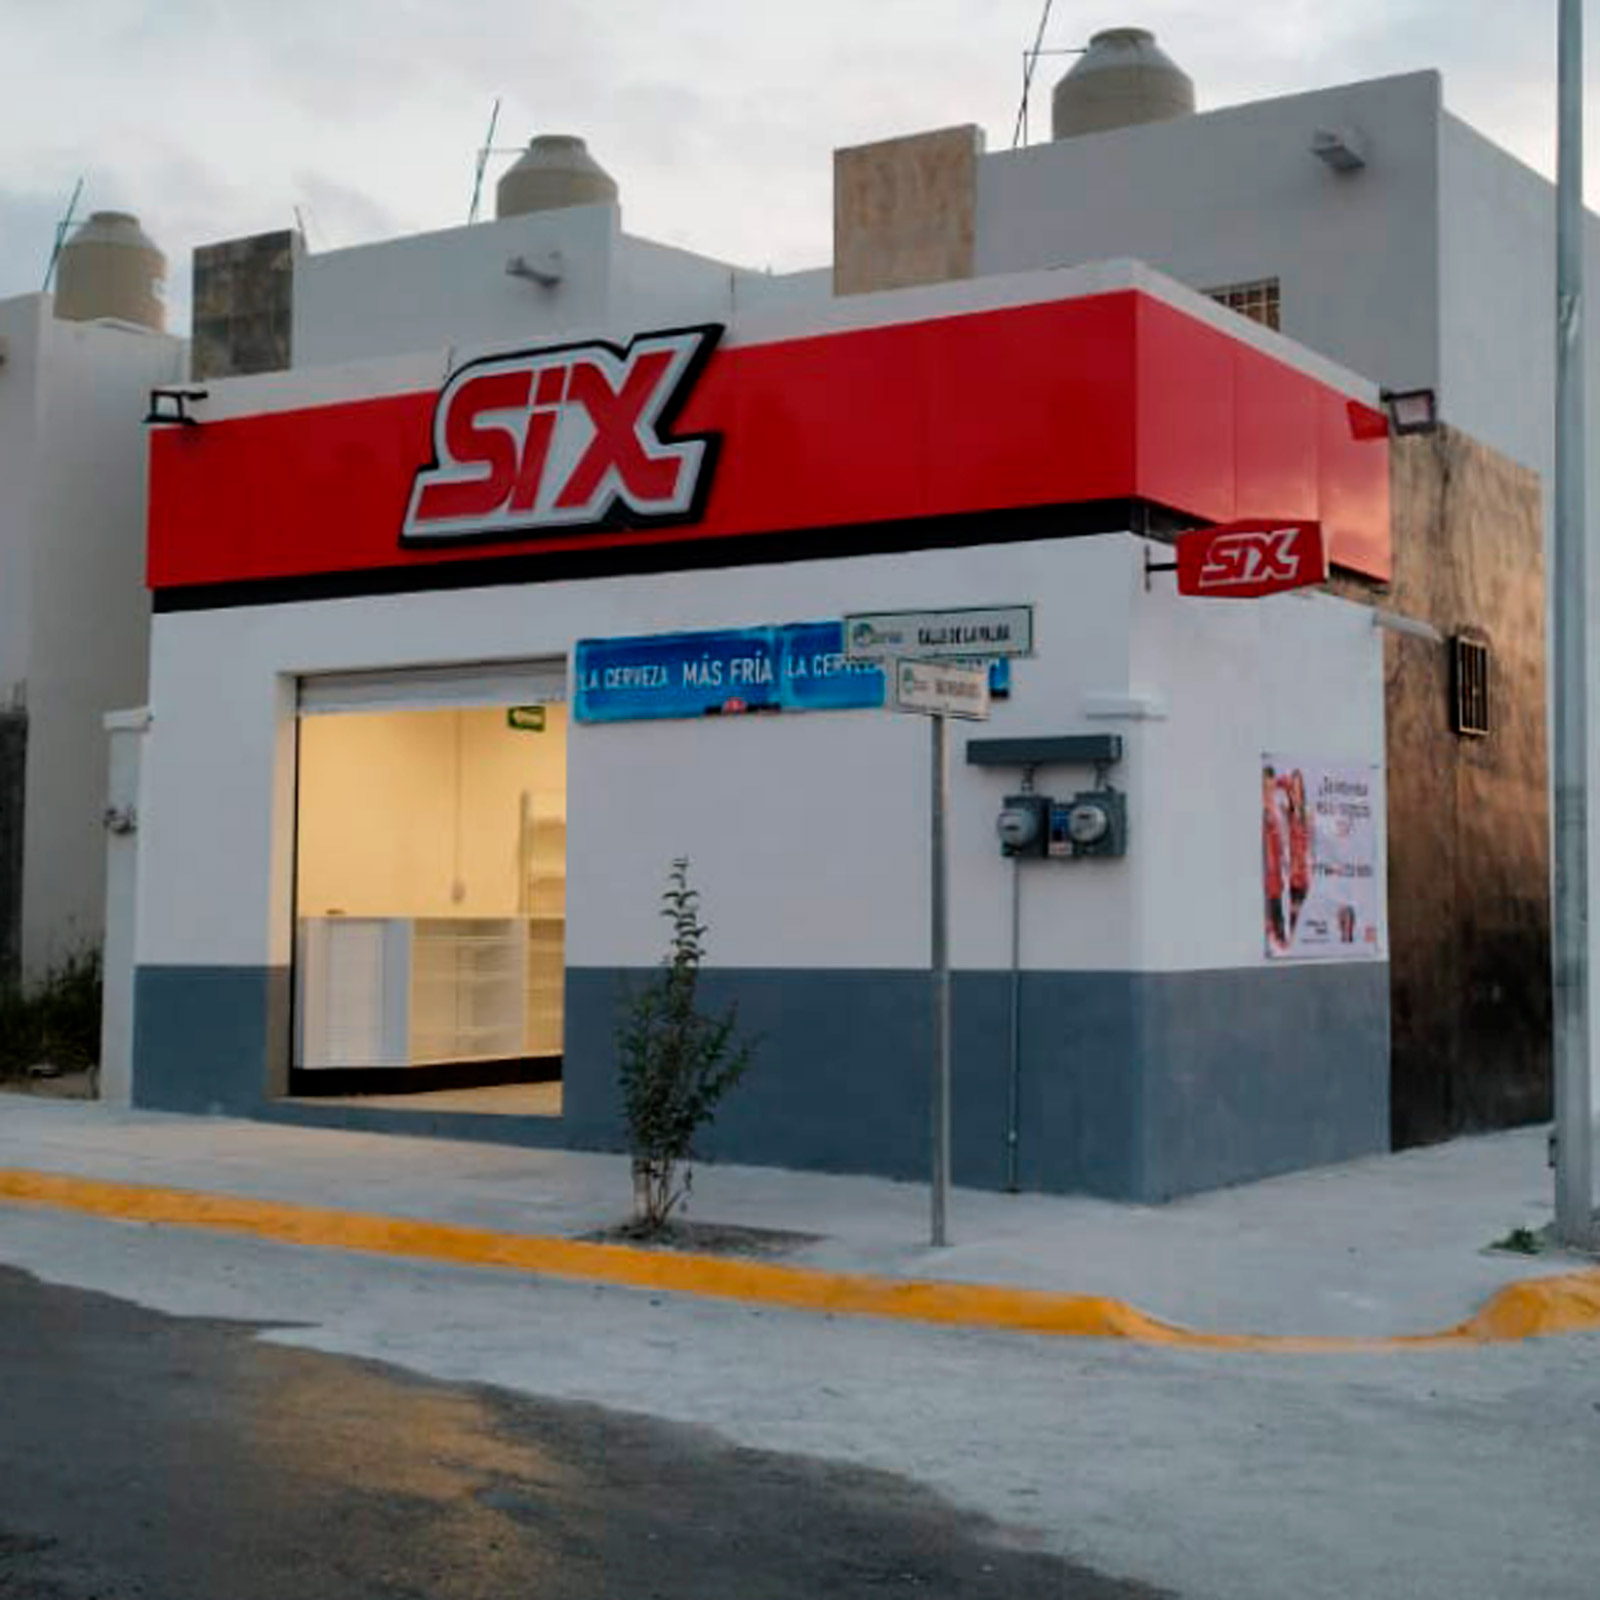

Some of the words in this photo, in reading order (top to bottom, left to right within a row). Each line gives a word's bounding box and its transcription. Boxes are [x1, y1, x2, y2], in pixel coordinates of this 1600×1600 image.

[580, 668, 598, 691] LA
[604, 665, 669, 690] CERVEZA
[683, 652, 723, 688] MÁS
[730, 650, 773, 686] FRÍA
[788, 655, 808, 677] LA
